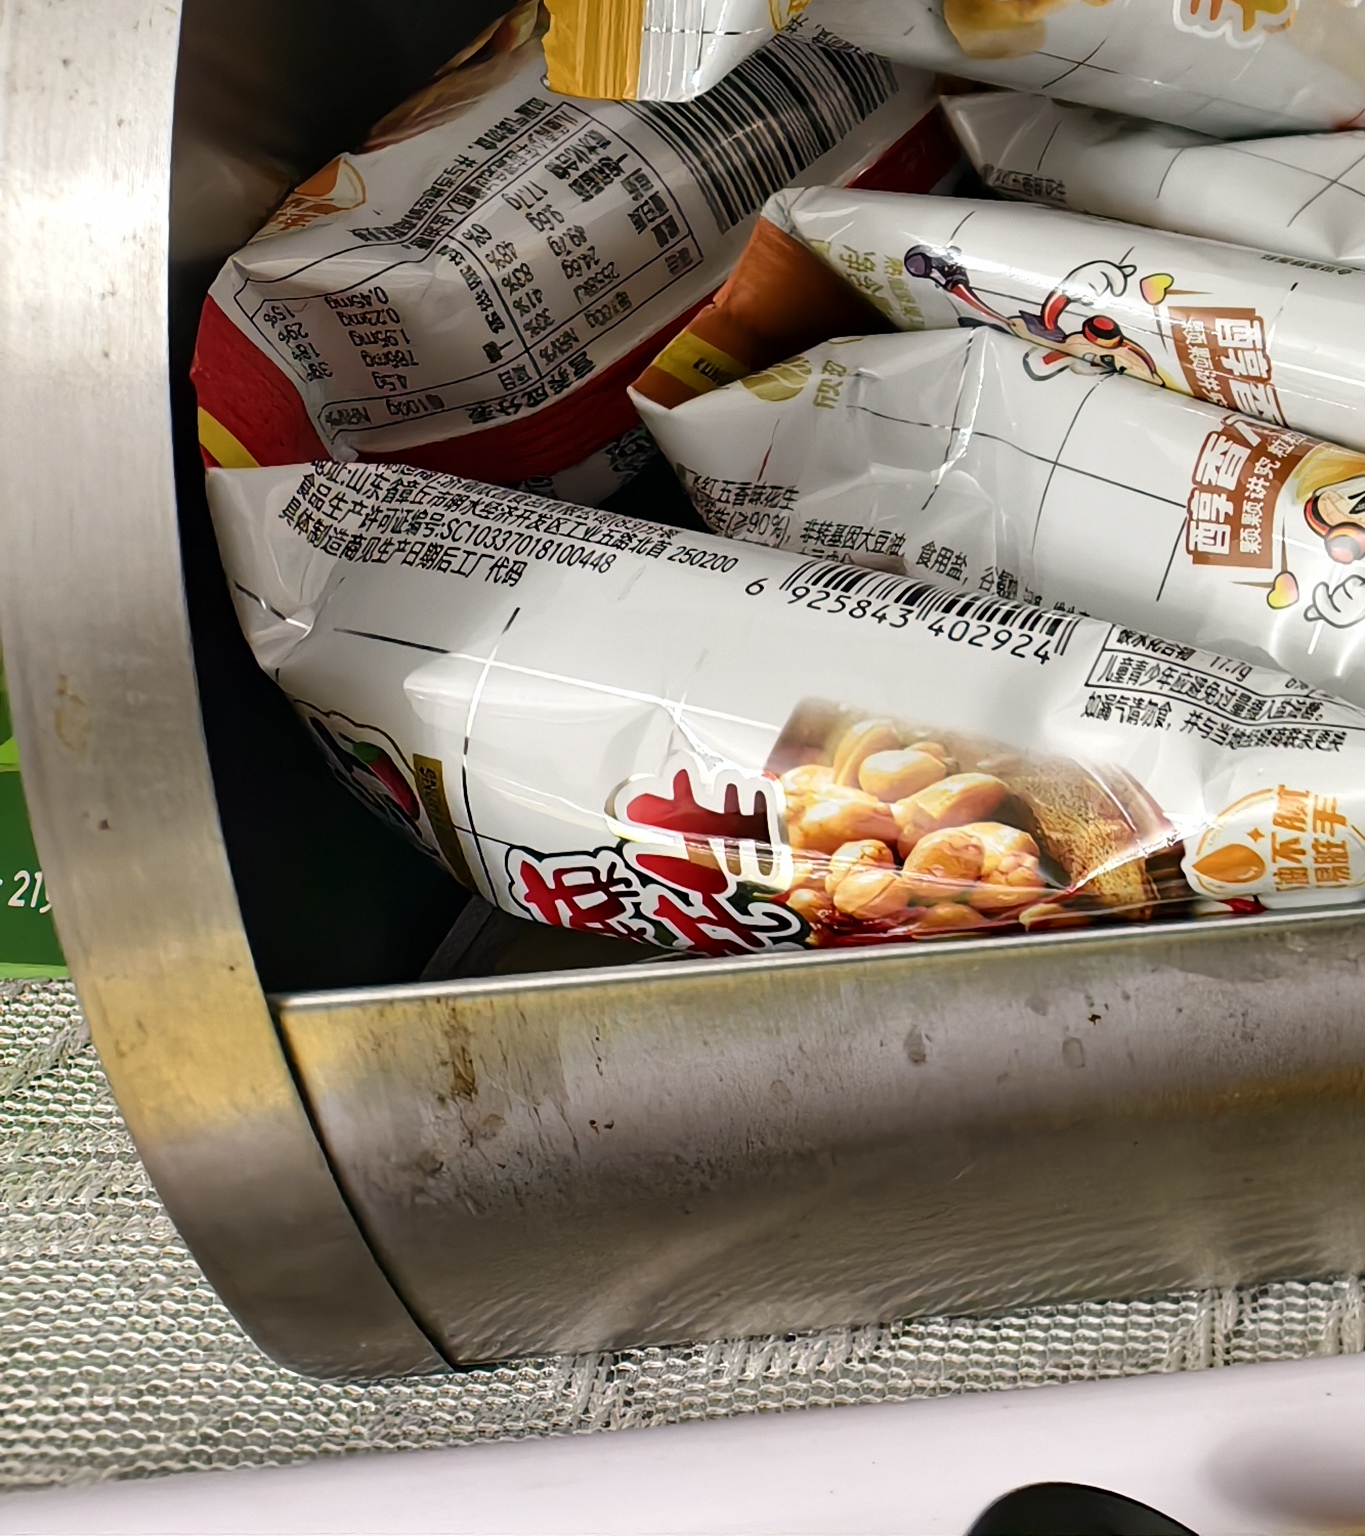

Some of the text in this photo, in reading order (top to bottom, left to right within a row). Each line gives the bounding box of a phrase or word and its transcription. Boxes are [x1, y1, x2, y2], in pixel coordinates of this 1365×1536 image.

[467, 349, 598, 426] 营养成分表
[275, 498, 529, 588] 具体制造商见生产日期后工厂代码
[291, 471, 619, 575] 食品生产许可证编号:SC10337018100448
[1237, 452, 1282, 557] 颗颗讲究
[667, 542, 740, 575] 250200
[744, 575, 1053, 666] 6 925843 402924
